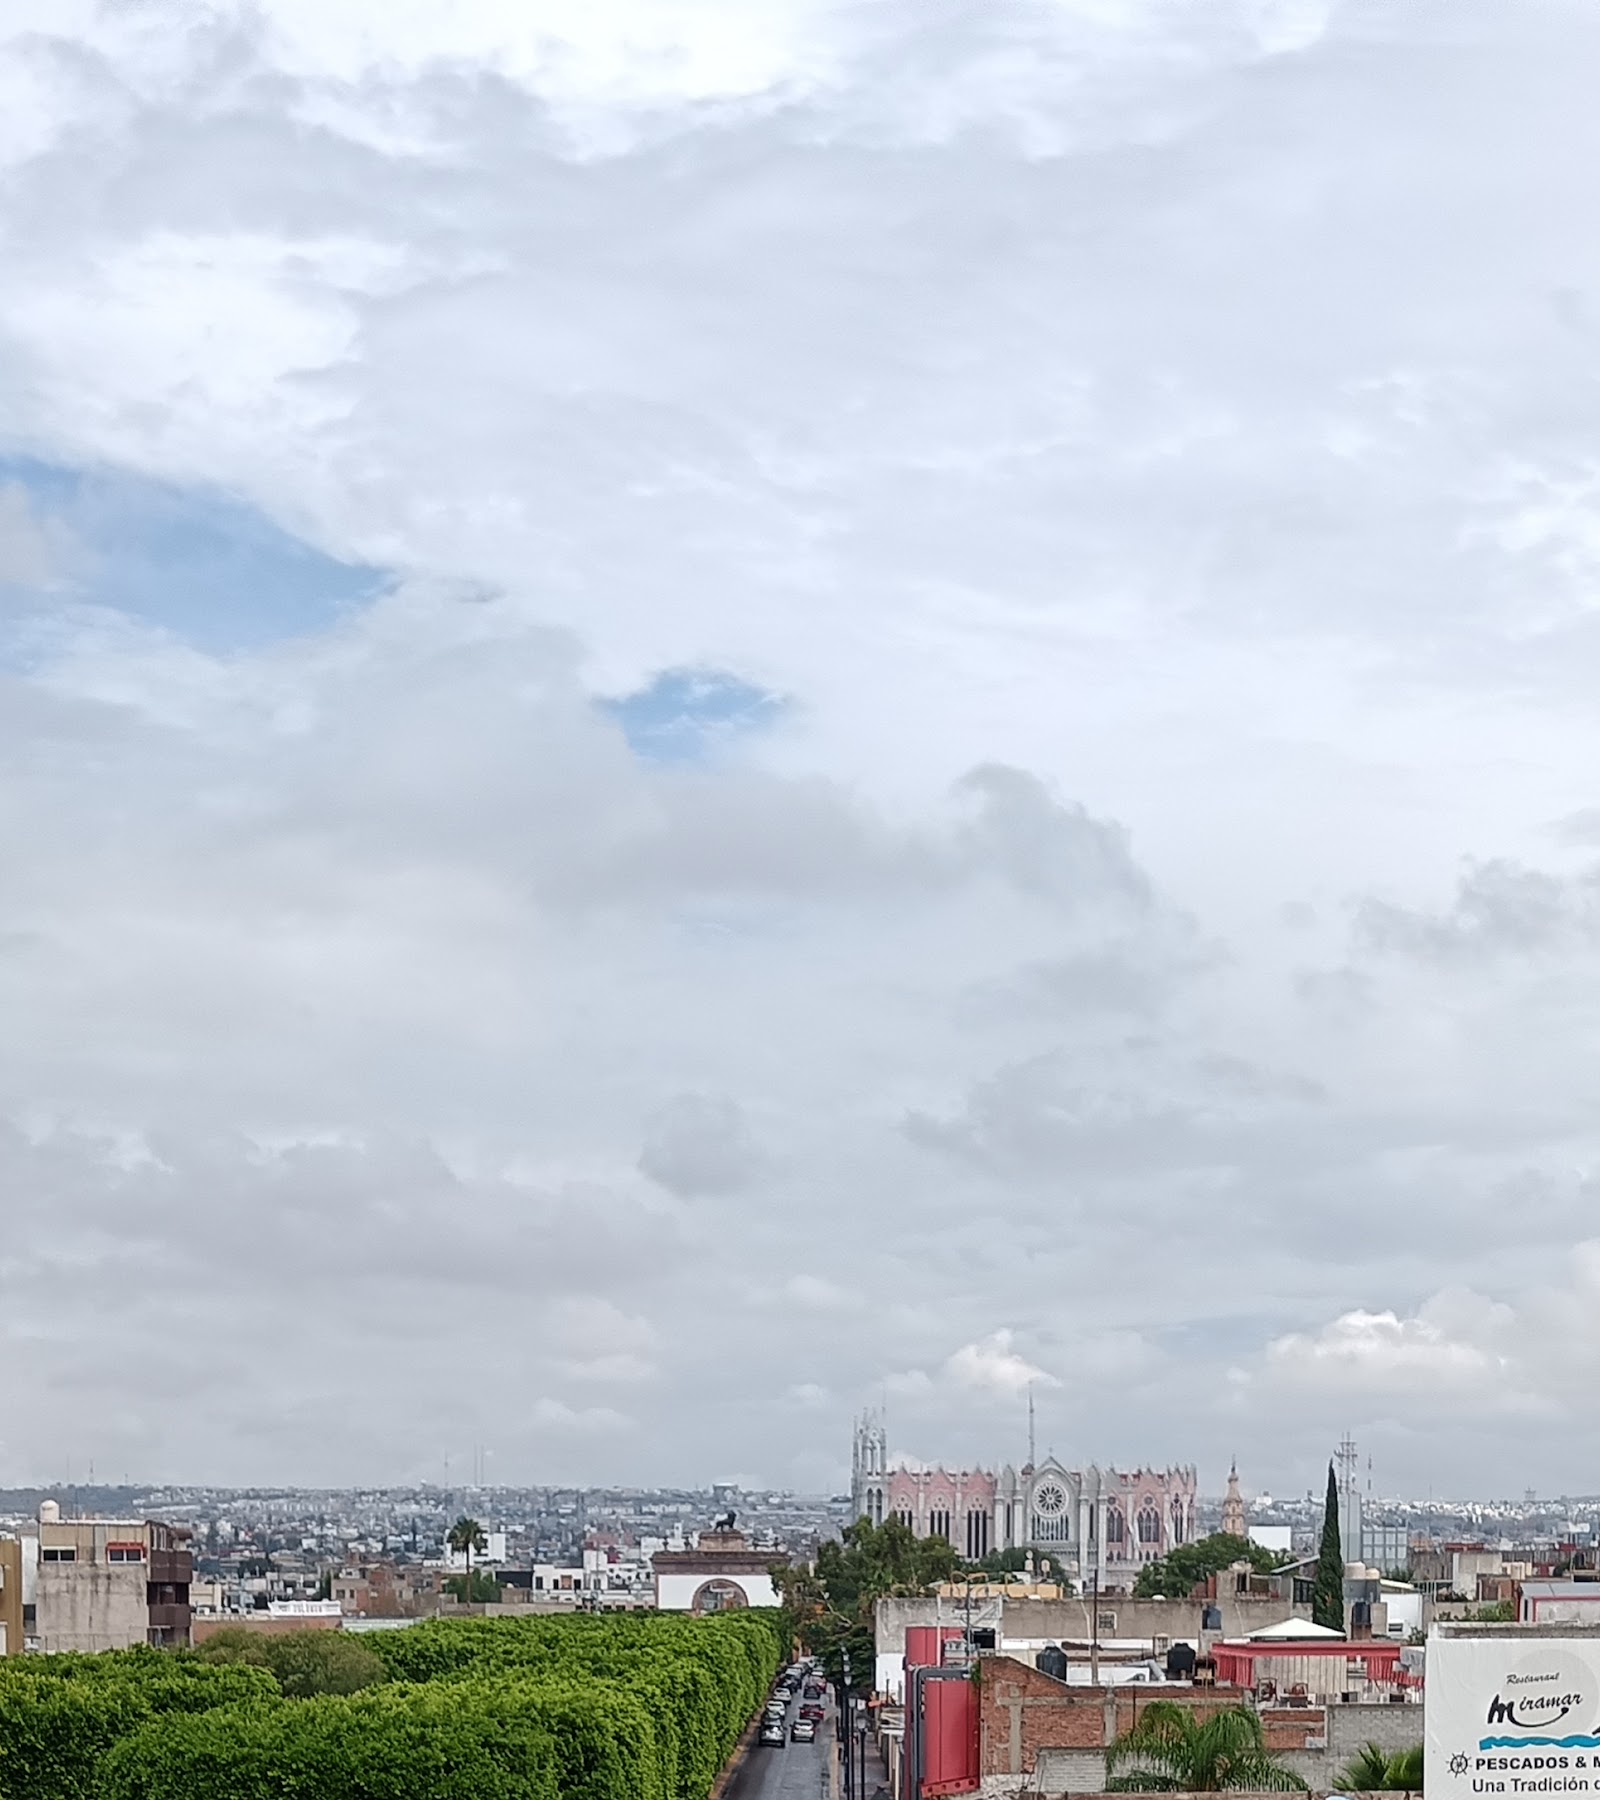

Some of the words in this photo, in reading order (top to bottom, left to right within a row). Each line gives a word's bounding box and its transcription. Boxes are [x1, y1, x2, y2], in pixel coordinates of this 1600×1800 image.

[1505, 1671, 1561, 1686] Restaurant
[1475, 1757, 1569, 1771] PESCADOS
[1575, 1756, 1587, 1769] &
[1472, 1777, 1506, 1794] Una
[1510, 1775, 1589, 1793] Tradición
